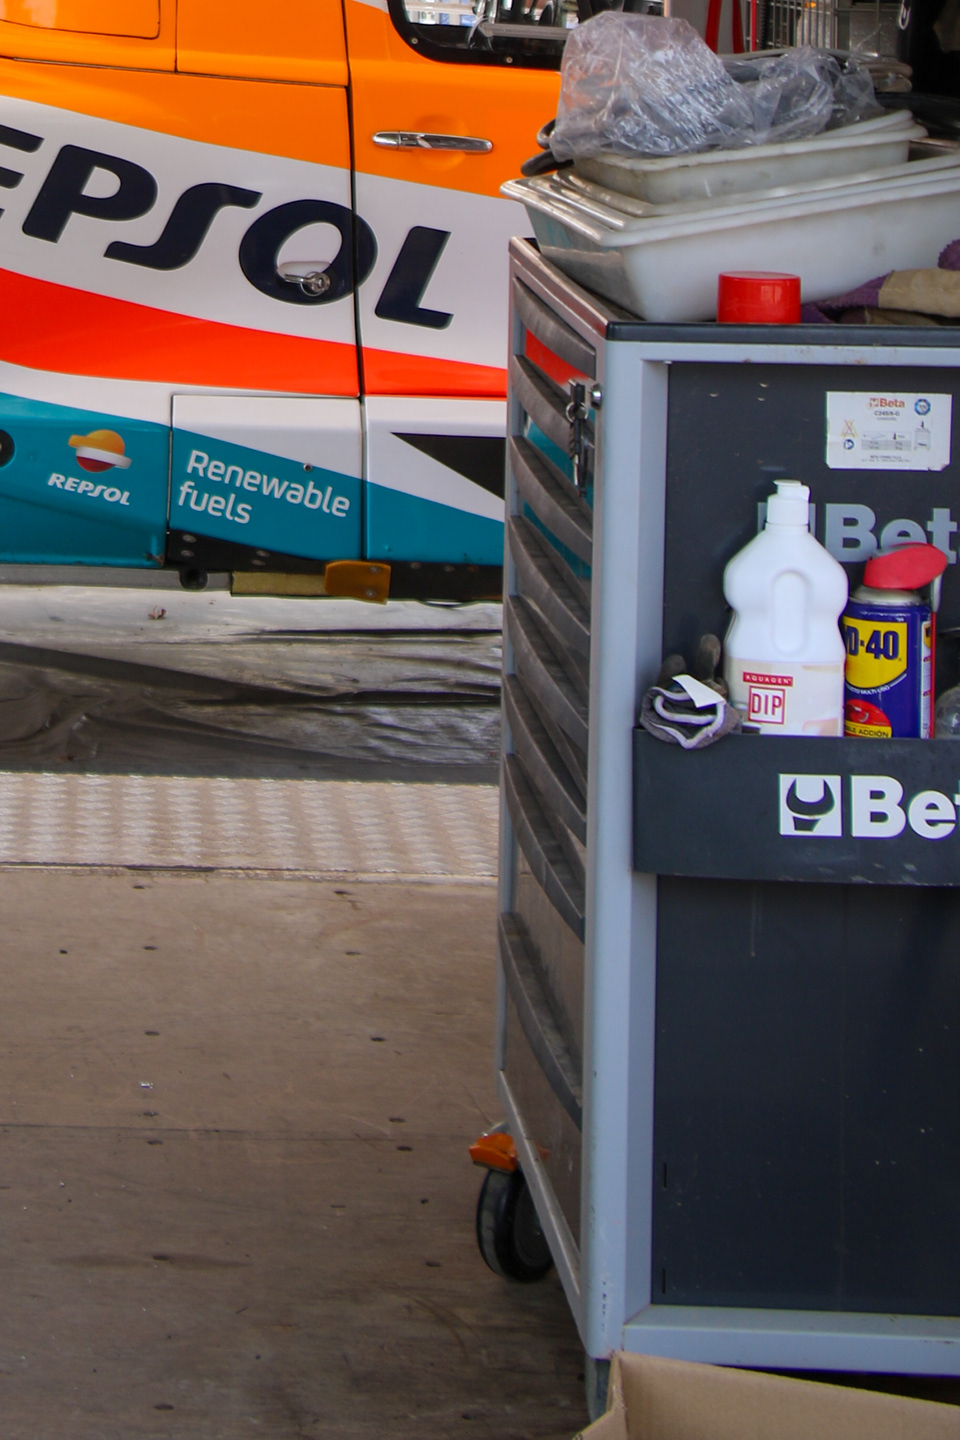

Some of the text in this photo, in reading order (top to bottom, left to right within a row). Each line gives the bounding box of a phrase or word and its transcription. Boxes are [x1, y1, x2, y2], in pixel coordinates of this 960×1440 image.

[879, 398, 905, 408] Beta
[47, 473, 131, 505] REPSOL
[178, 481, 252, 525] fuels
[187, 449, 351, 518] Renewable
[825, 503, 960, 564] Bet
[751, 693, 783, 716] DIP
[850, 775, 960, 840] Be
